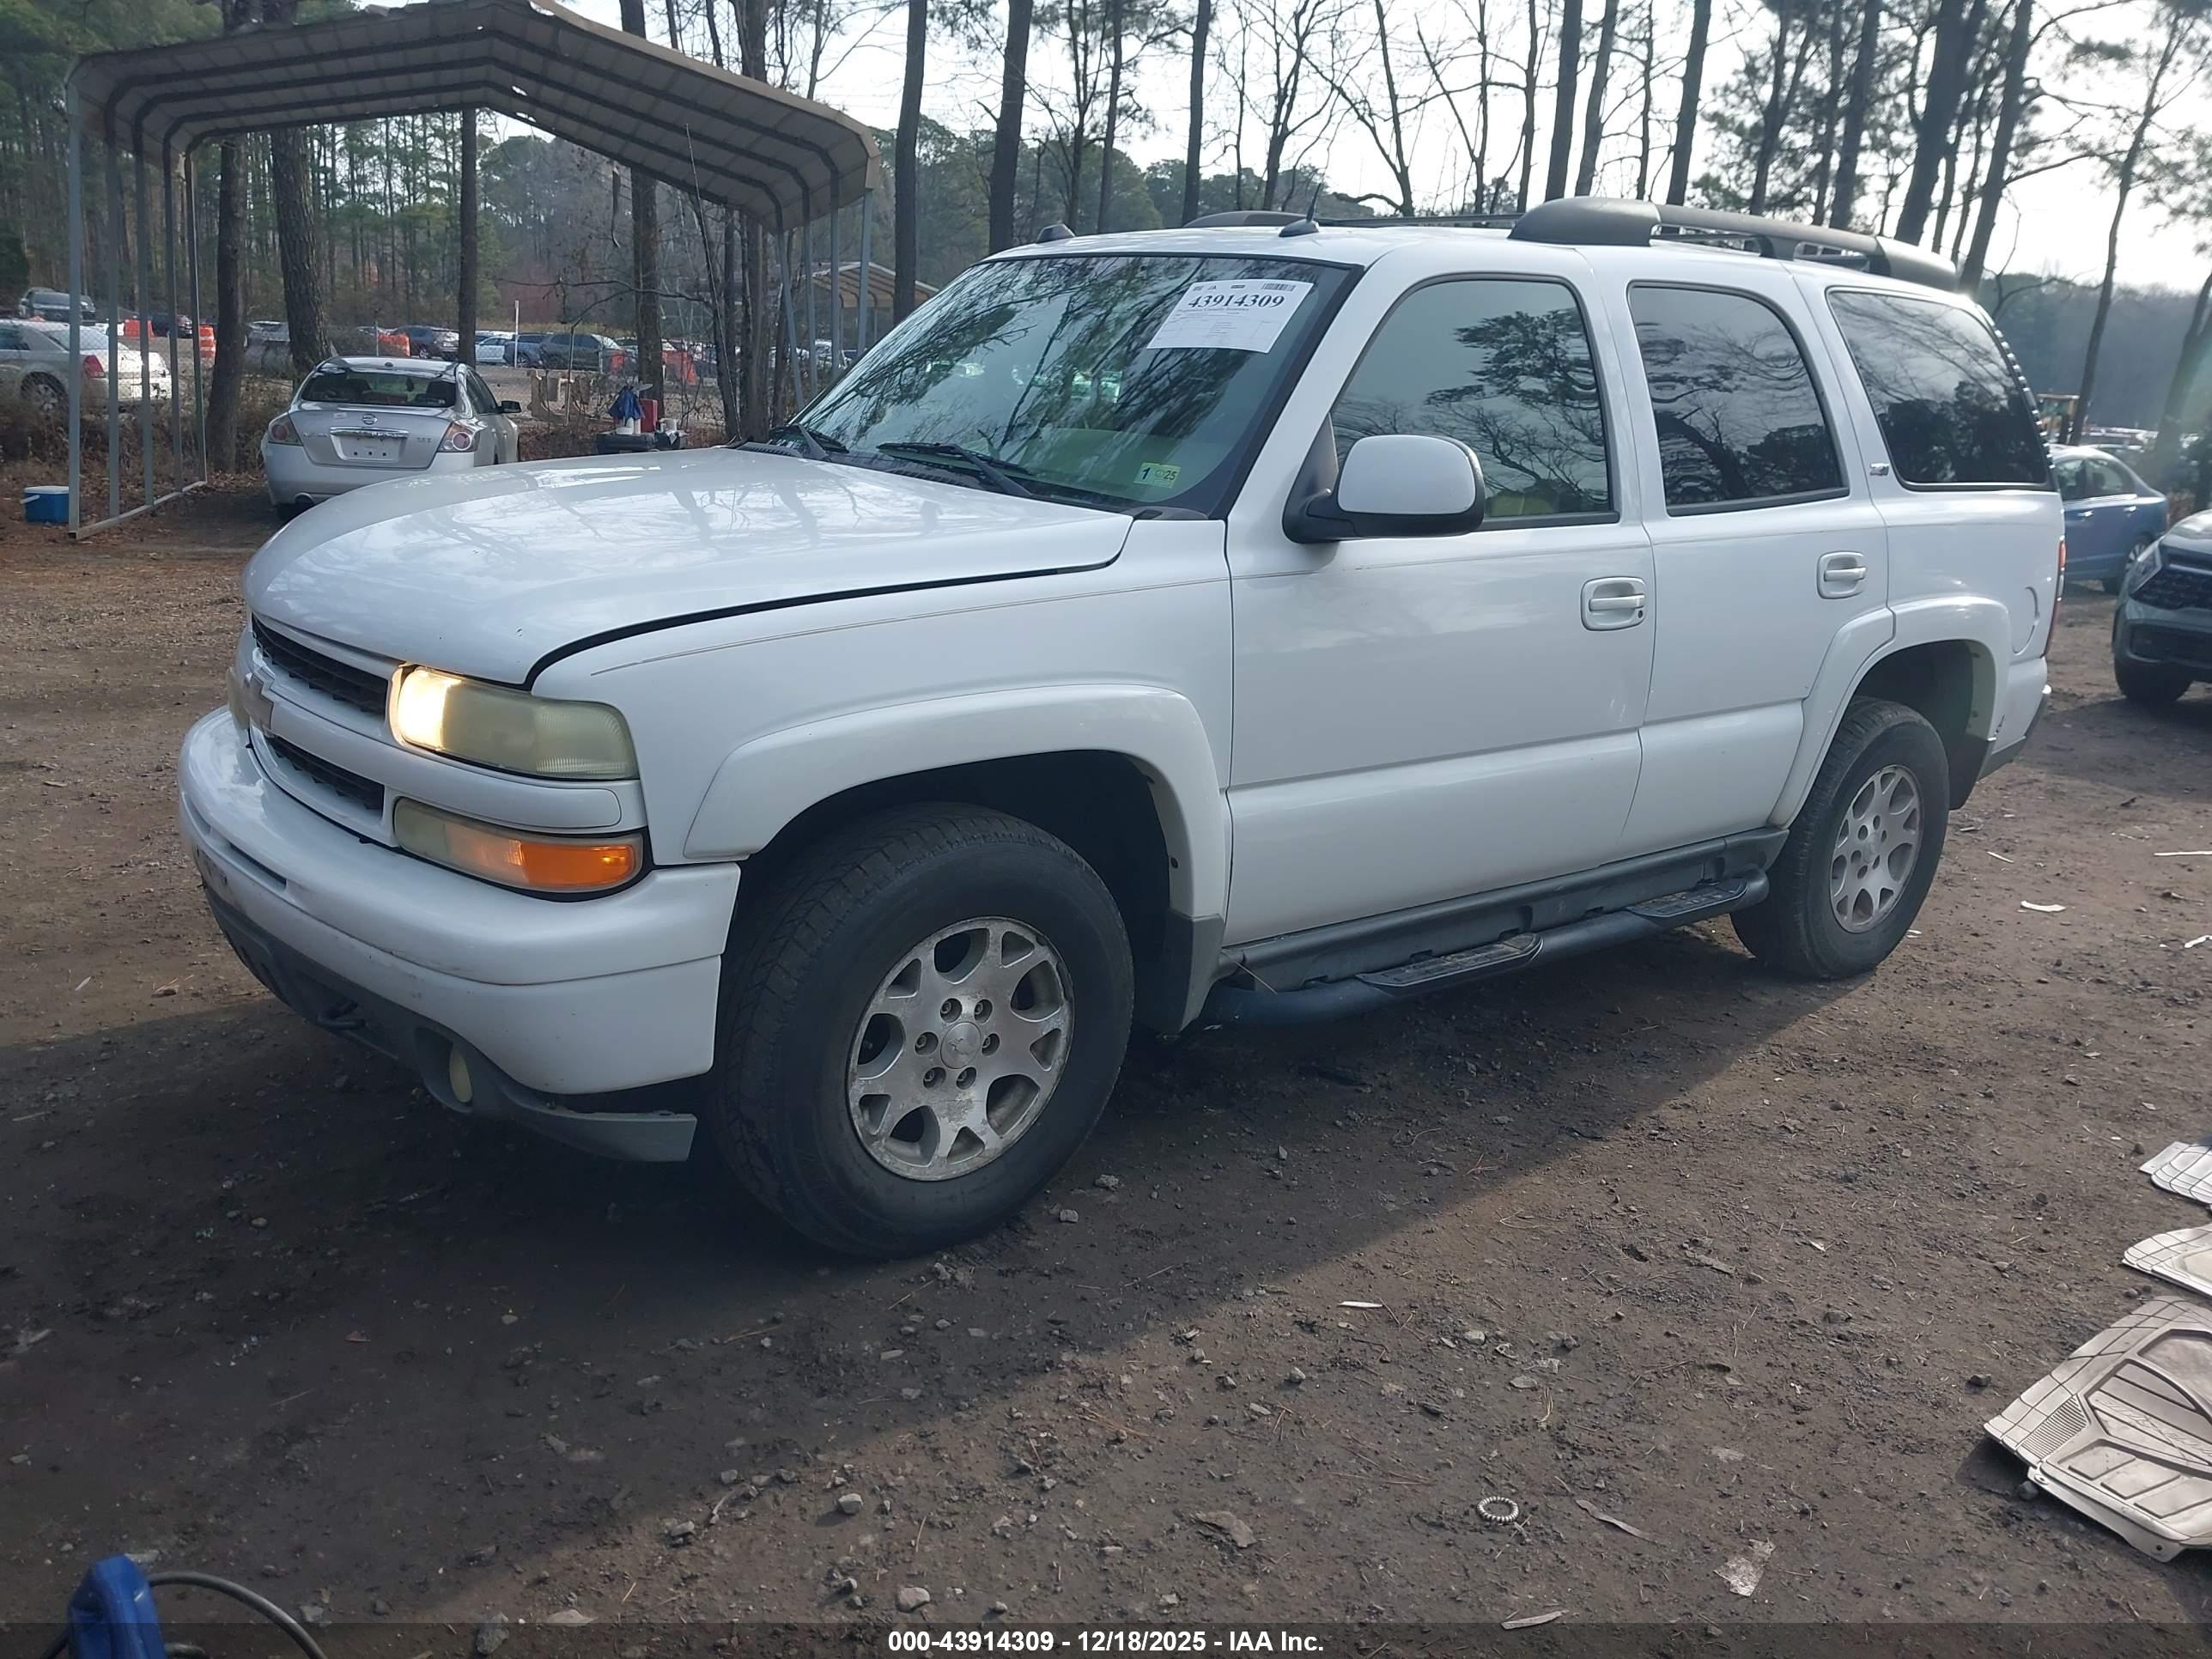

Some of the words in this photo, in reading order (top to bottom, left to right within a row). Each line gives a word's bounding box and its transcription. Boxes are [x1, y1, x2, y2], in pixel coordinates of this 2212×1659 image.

[1188, 294, 1285, 308] 43914309
[1142, 466, 1152, 480] 1
[1164, 470, 1177, 481] 25
